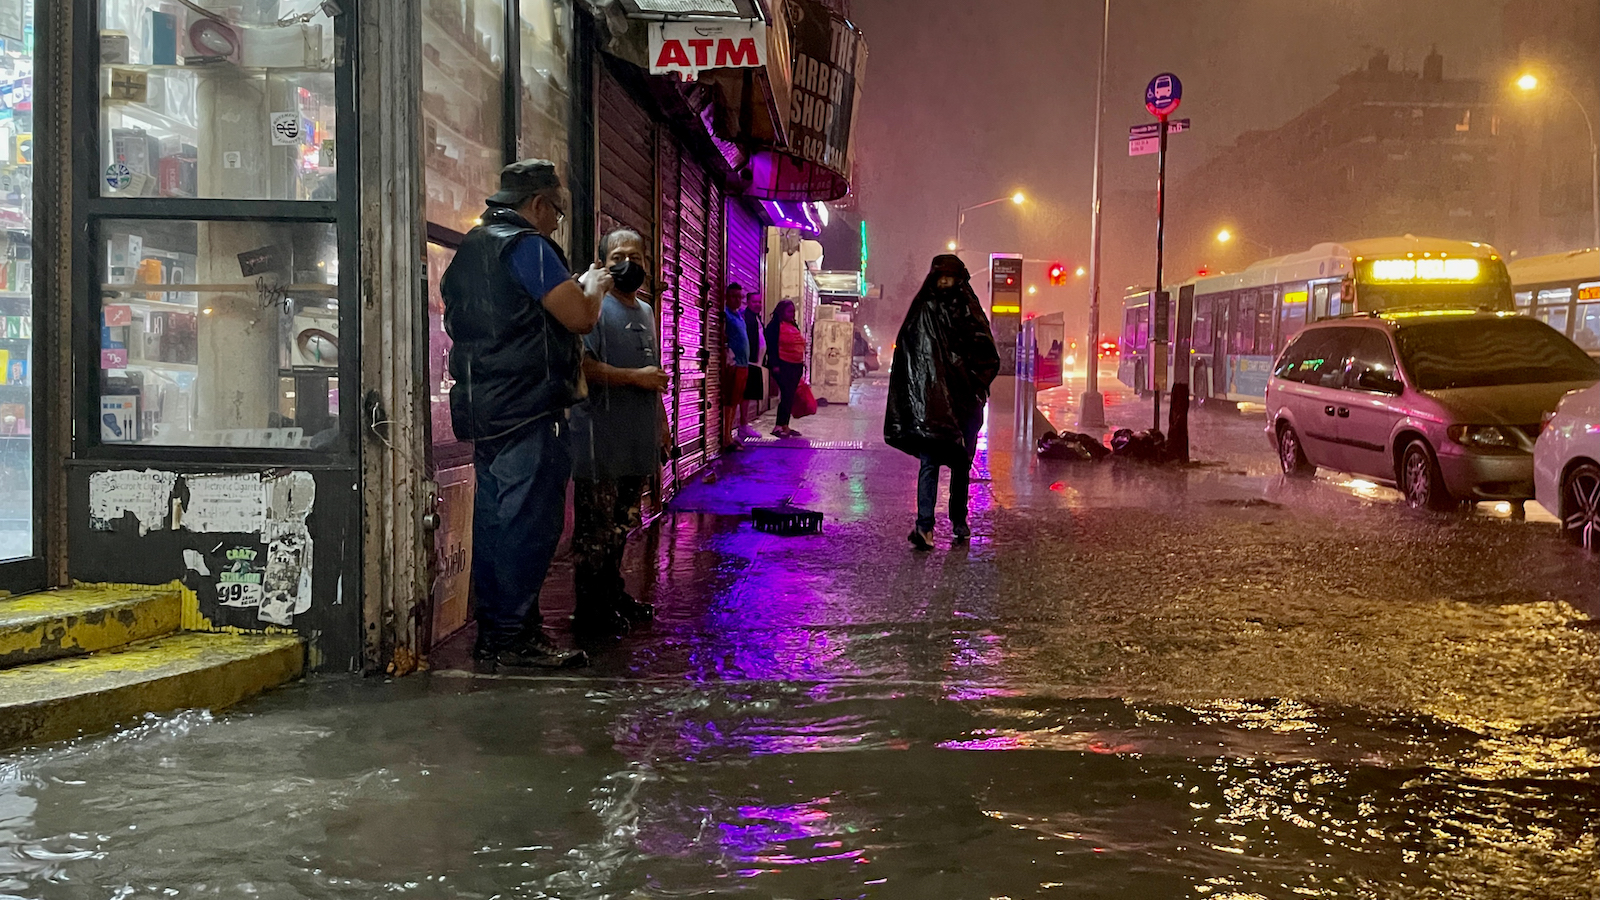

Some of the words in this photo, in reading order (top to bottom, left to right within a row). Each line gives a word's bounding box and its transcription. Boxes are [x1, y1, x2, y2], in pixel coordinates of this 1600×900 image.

[656, 37, 760, 67] ATM
[830, 17, 856, 75] THE
[790, 88, 834, 135] SHOP
[226, 549, 257, 561] CRAZY
